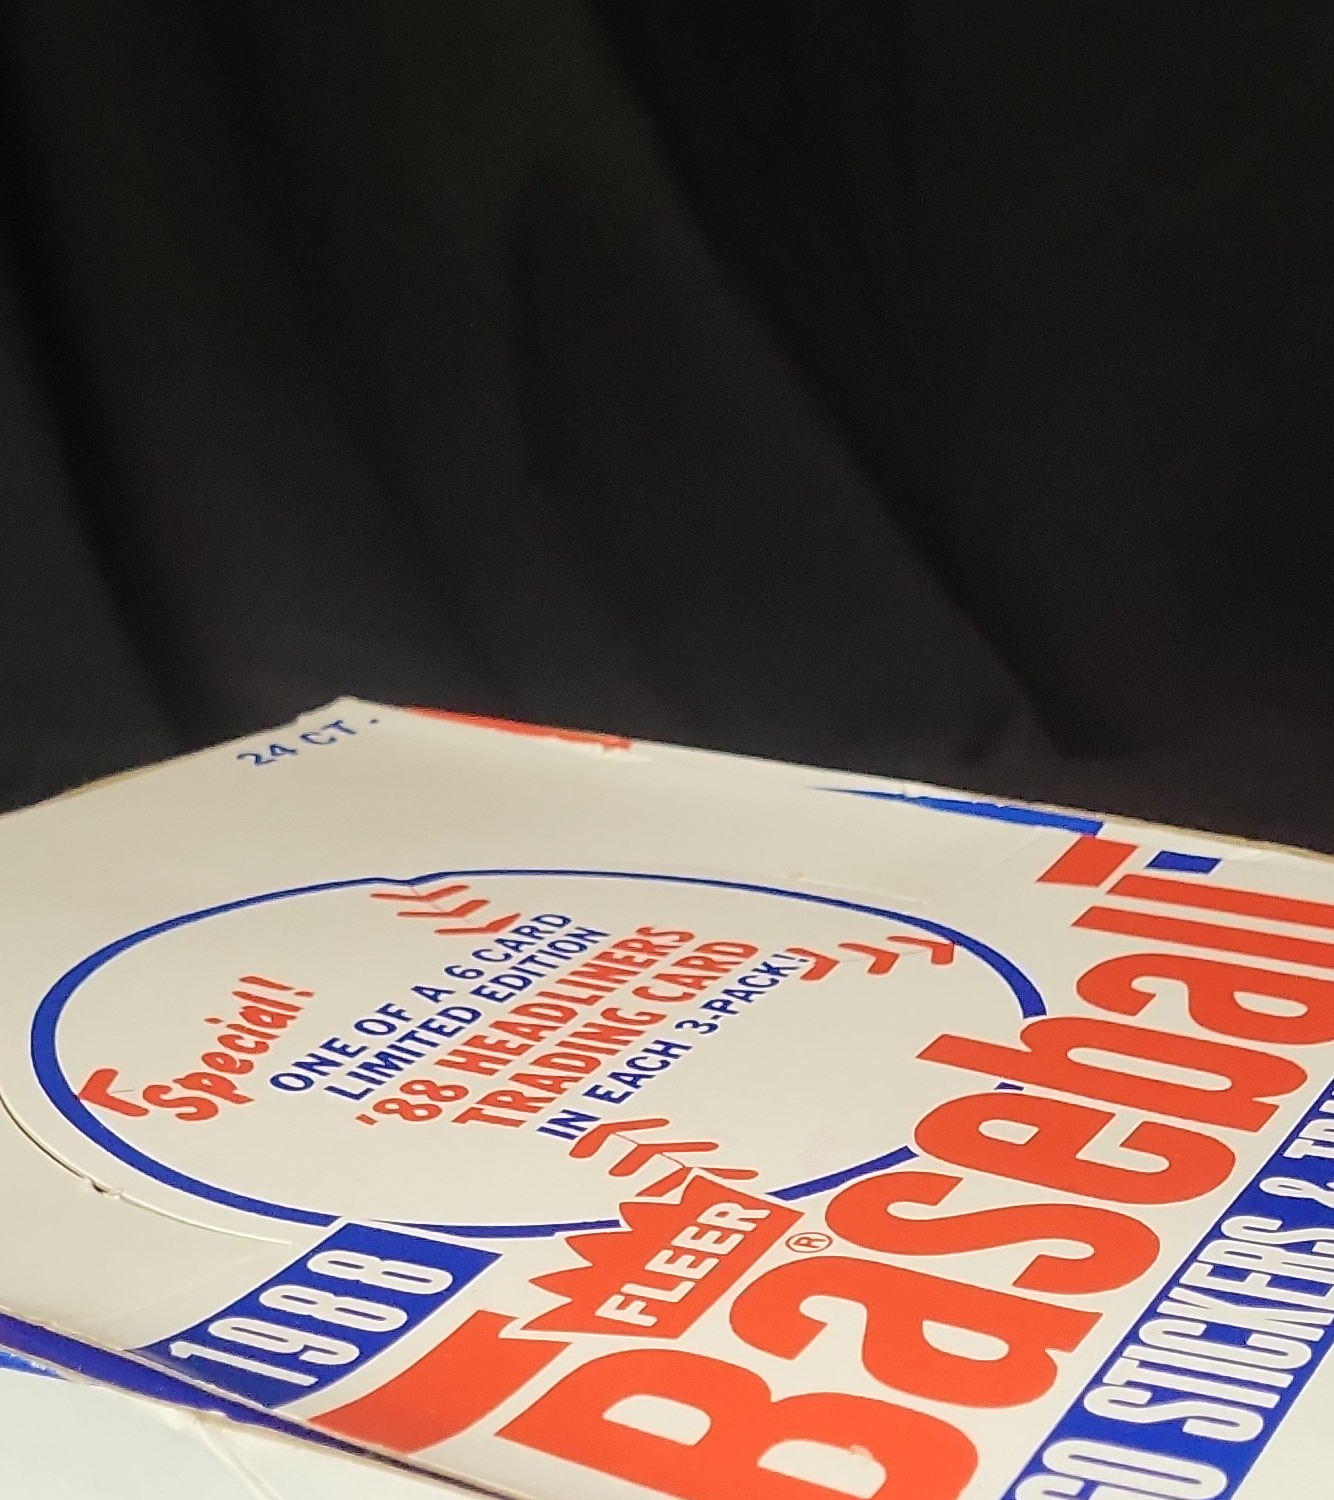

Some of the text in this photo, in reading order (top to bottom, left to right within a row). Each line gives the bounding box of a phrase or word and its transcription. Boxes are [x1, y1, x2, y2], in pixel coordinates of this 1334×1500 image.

[236, 743, 299, 766] 24
[142, 975, 315, 1121] Special!
[269, 913, 572, 1092] ONE OF A 6 CARD
[324, 927, 611, 1100] LIMITED EDITION
[355, 927, 695, 1126] '88 HEADLINERS
[450, 941, 759, 1128] TRADING CARD
[536, 954, 811, 1140] IN EACH 3-PACK!
[168, 1248, 453, 1387] 1988
[595, 1200, 770, 1328] FLEER
